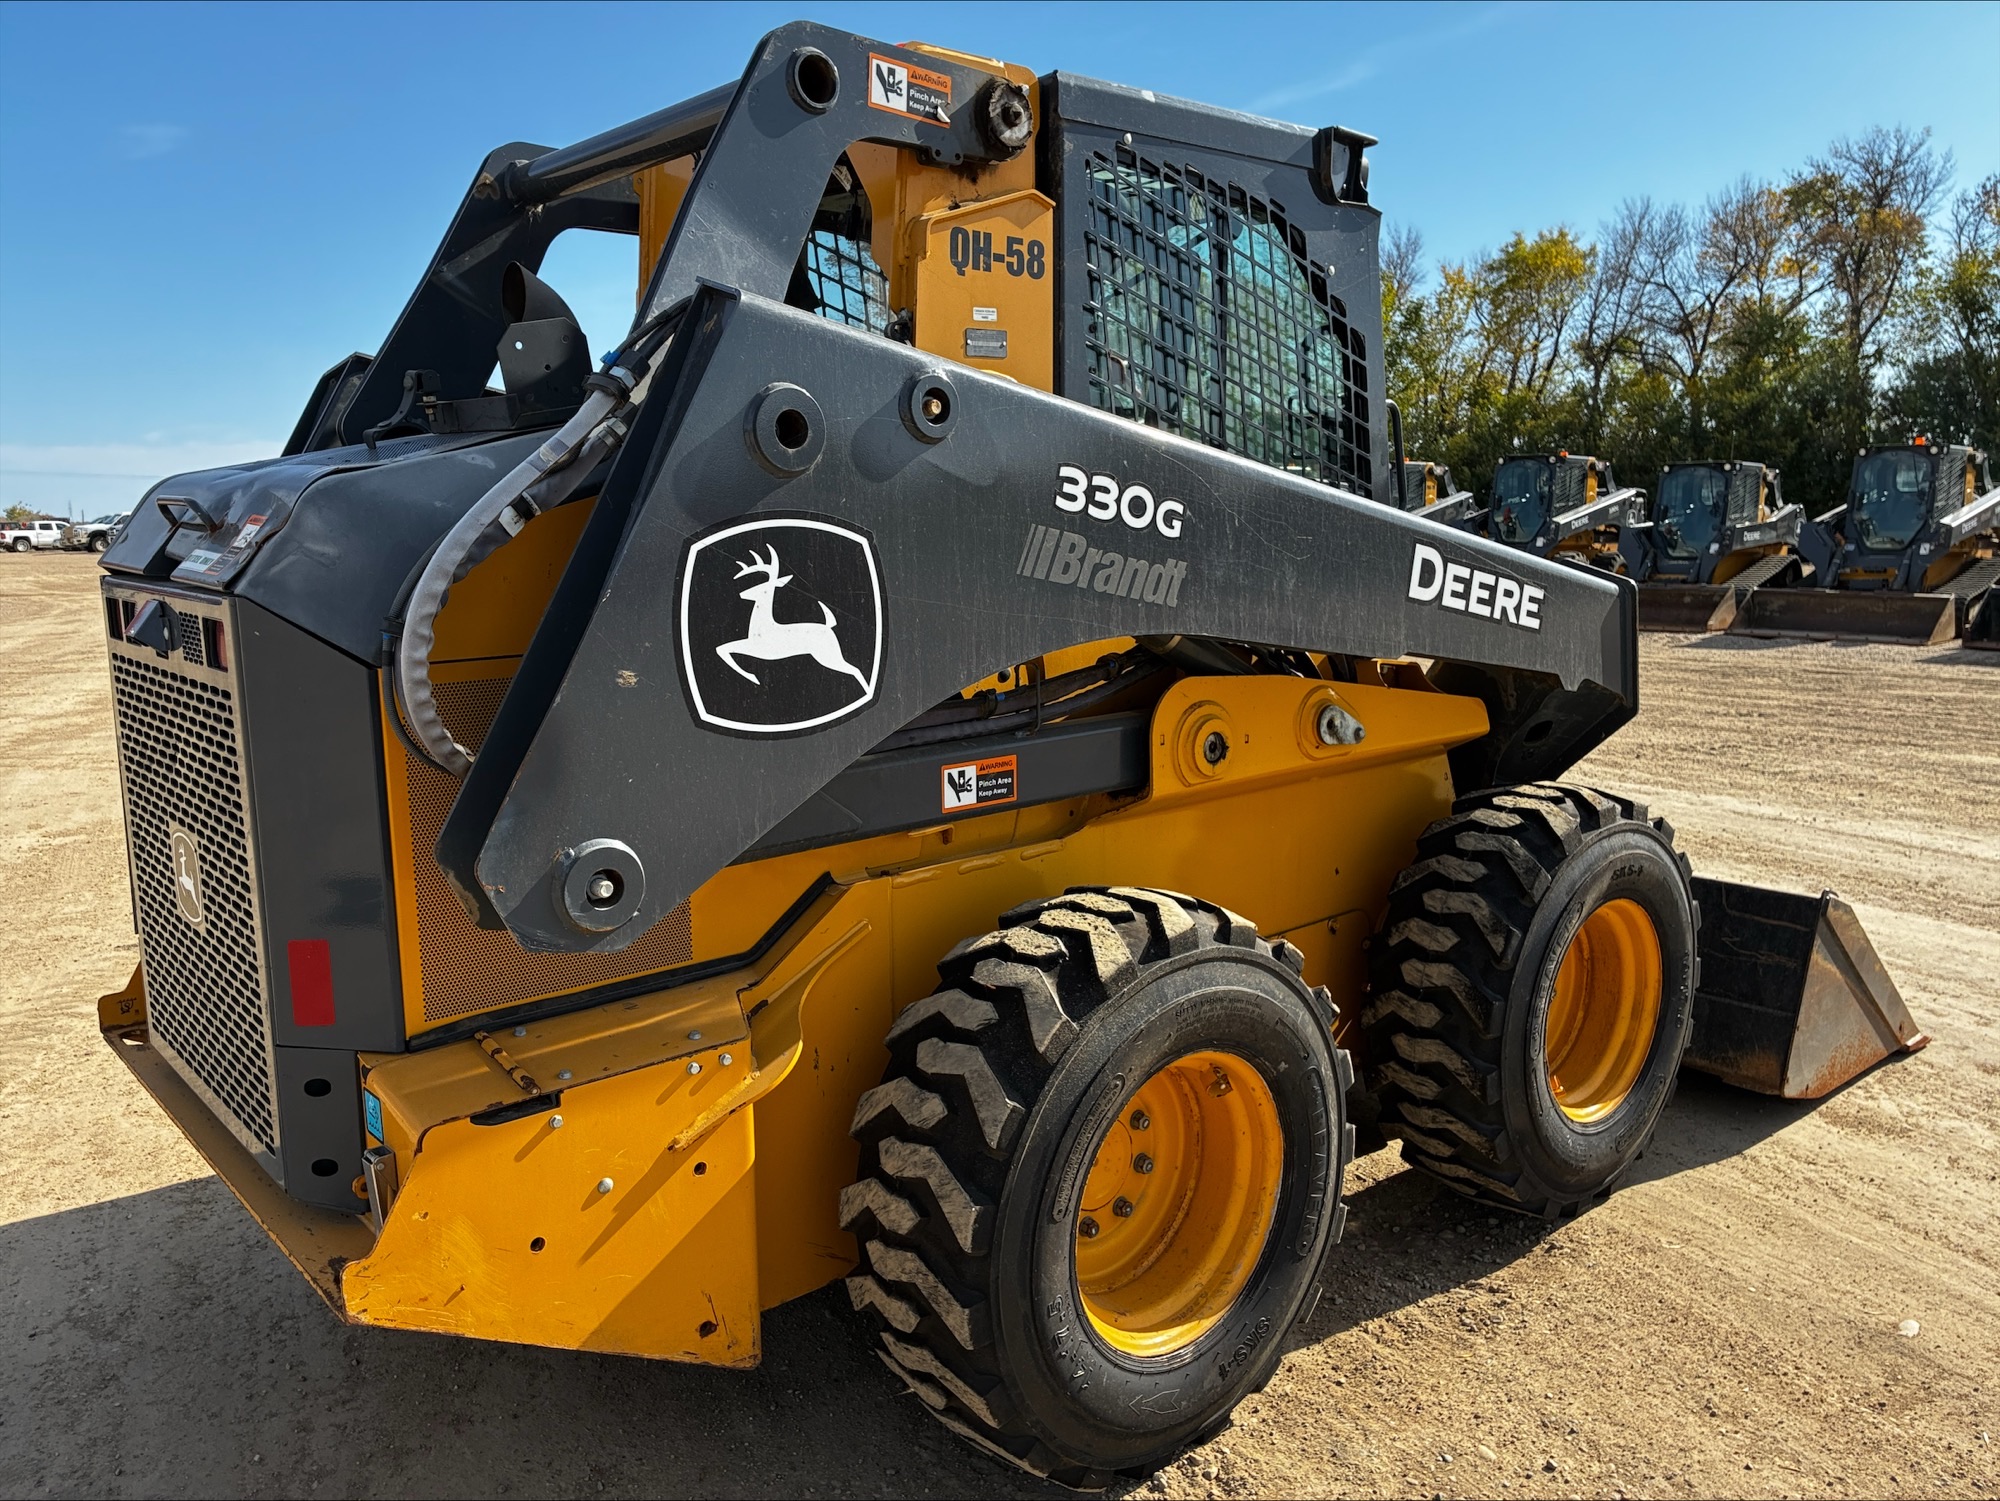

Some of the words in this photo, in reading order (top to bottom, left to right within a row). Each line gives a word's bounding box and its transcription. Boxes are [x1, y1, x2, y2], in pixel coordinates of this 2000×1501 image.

[917, 73, 948, 89] WARNING
[909, 89, 929, 102] Pinch
[909, 100, 925, 112] Keep
[950, 226, 1045, 280] QH-58
[1055, 466, 1184, 538] 330G
[1048, 531, 1188, 608] Brandt
[1408, 543, 1545, 630] DEERE
[985, 760, 1013, 770] WARNING
[978, 779, 997, 788] Pinch
[997, 777, 1012, 785] Area
